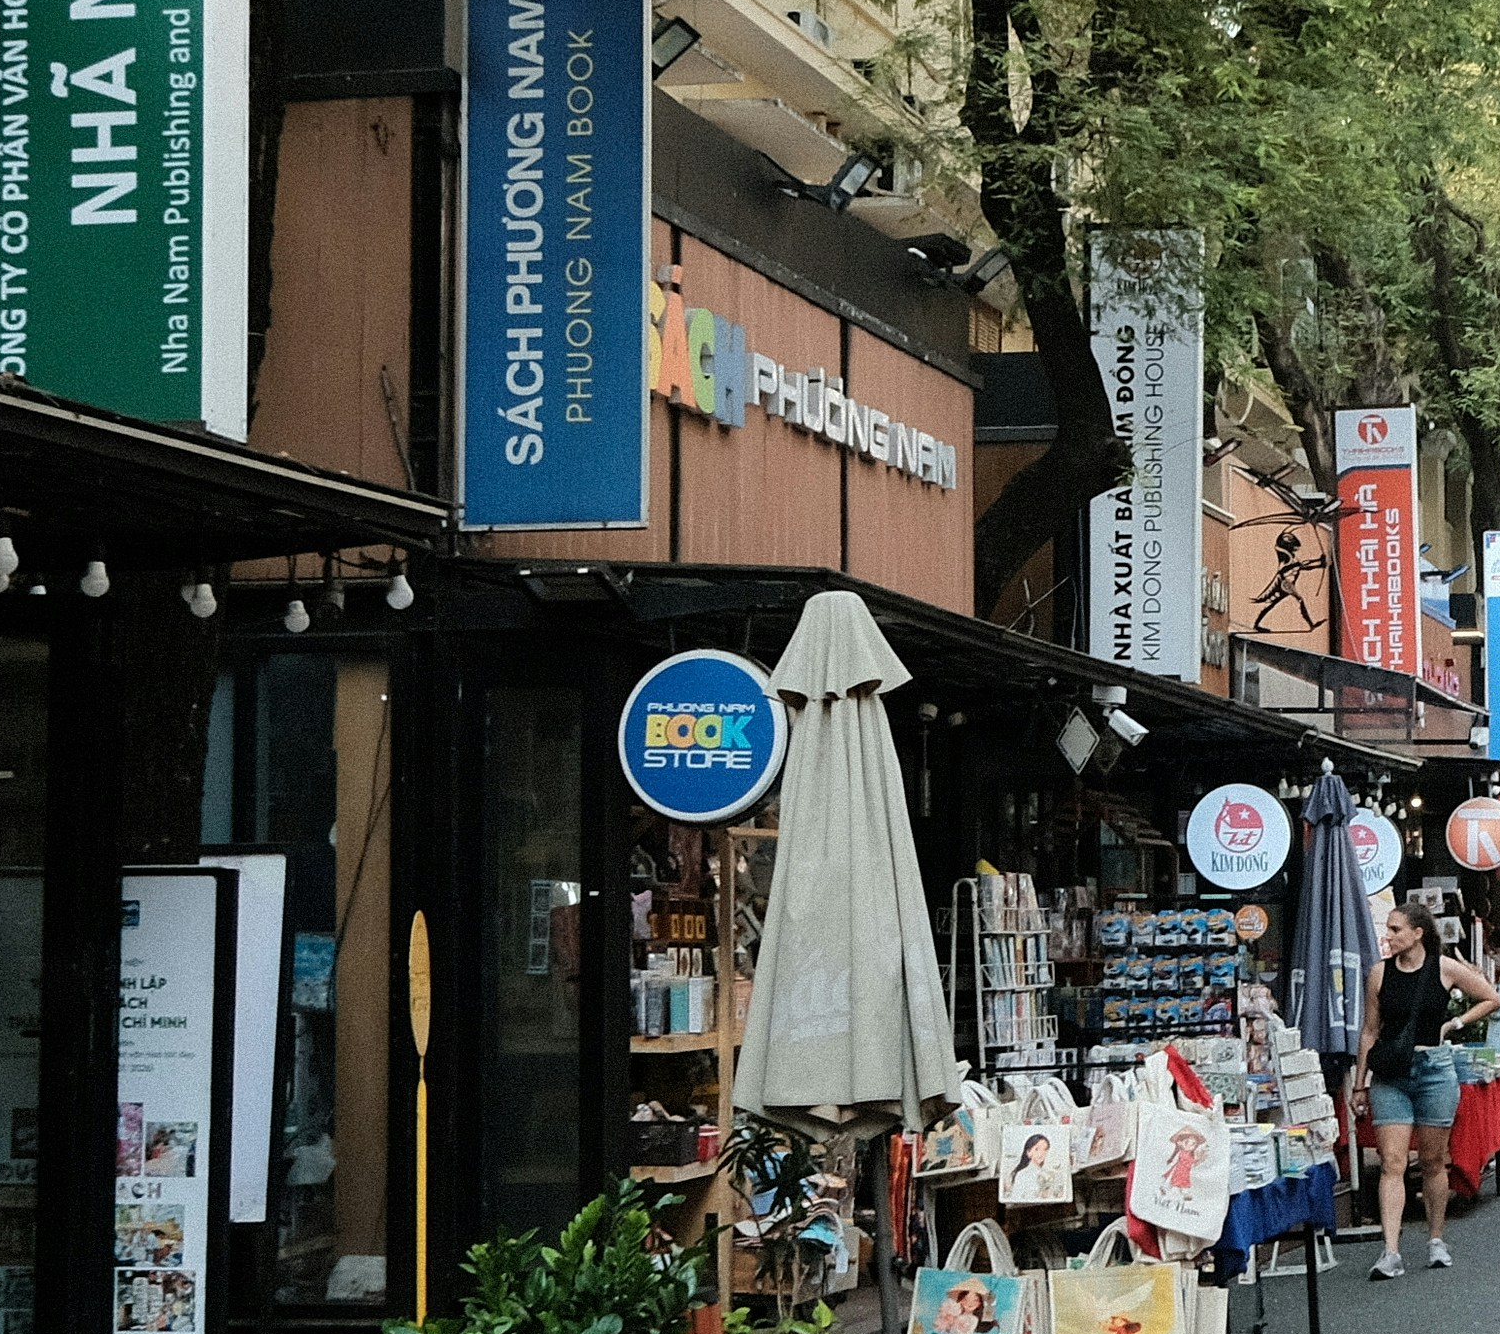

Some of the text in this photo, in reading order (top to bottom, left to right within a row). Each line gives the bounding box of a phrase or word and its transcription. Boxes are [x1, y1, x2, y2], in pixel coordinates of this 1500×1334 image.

[163, 10, 190, 63] and
[50, 47, 137, 226] NHÃ
[162, 72, 197, 224] Publishing
[506, 111, 545, 315] PHƯƠNG
[565, 28, 595, 423] PHUONG NAM BOOK
[0, 264, 28, 301] TY
[163, 236, 189, 304] Nam
[163, 315, 189, 374] Nha
[496, 327, 544, 465] SÁCH
[1114, 412, 1134, 447] IM
[1108, 488, 1133, 520] BẢ
[1143, 324, 1165, 661] KIM DONG PUBLISHING HOUSE
[1355, 539, 1381, 609] THÁI
[1108, 606, 1133, 661] NHÀ
[644, 713, 753, 749] BOOK
[647, 701, 756, 714] PHUONG NAM
[643, 748, 752, 770] STORE
[1211, 851, 1234, 872] KIM
[150, 1016, 188, 1029] MINH
